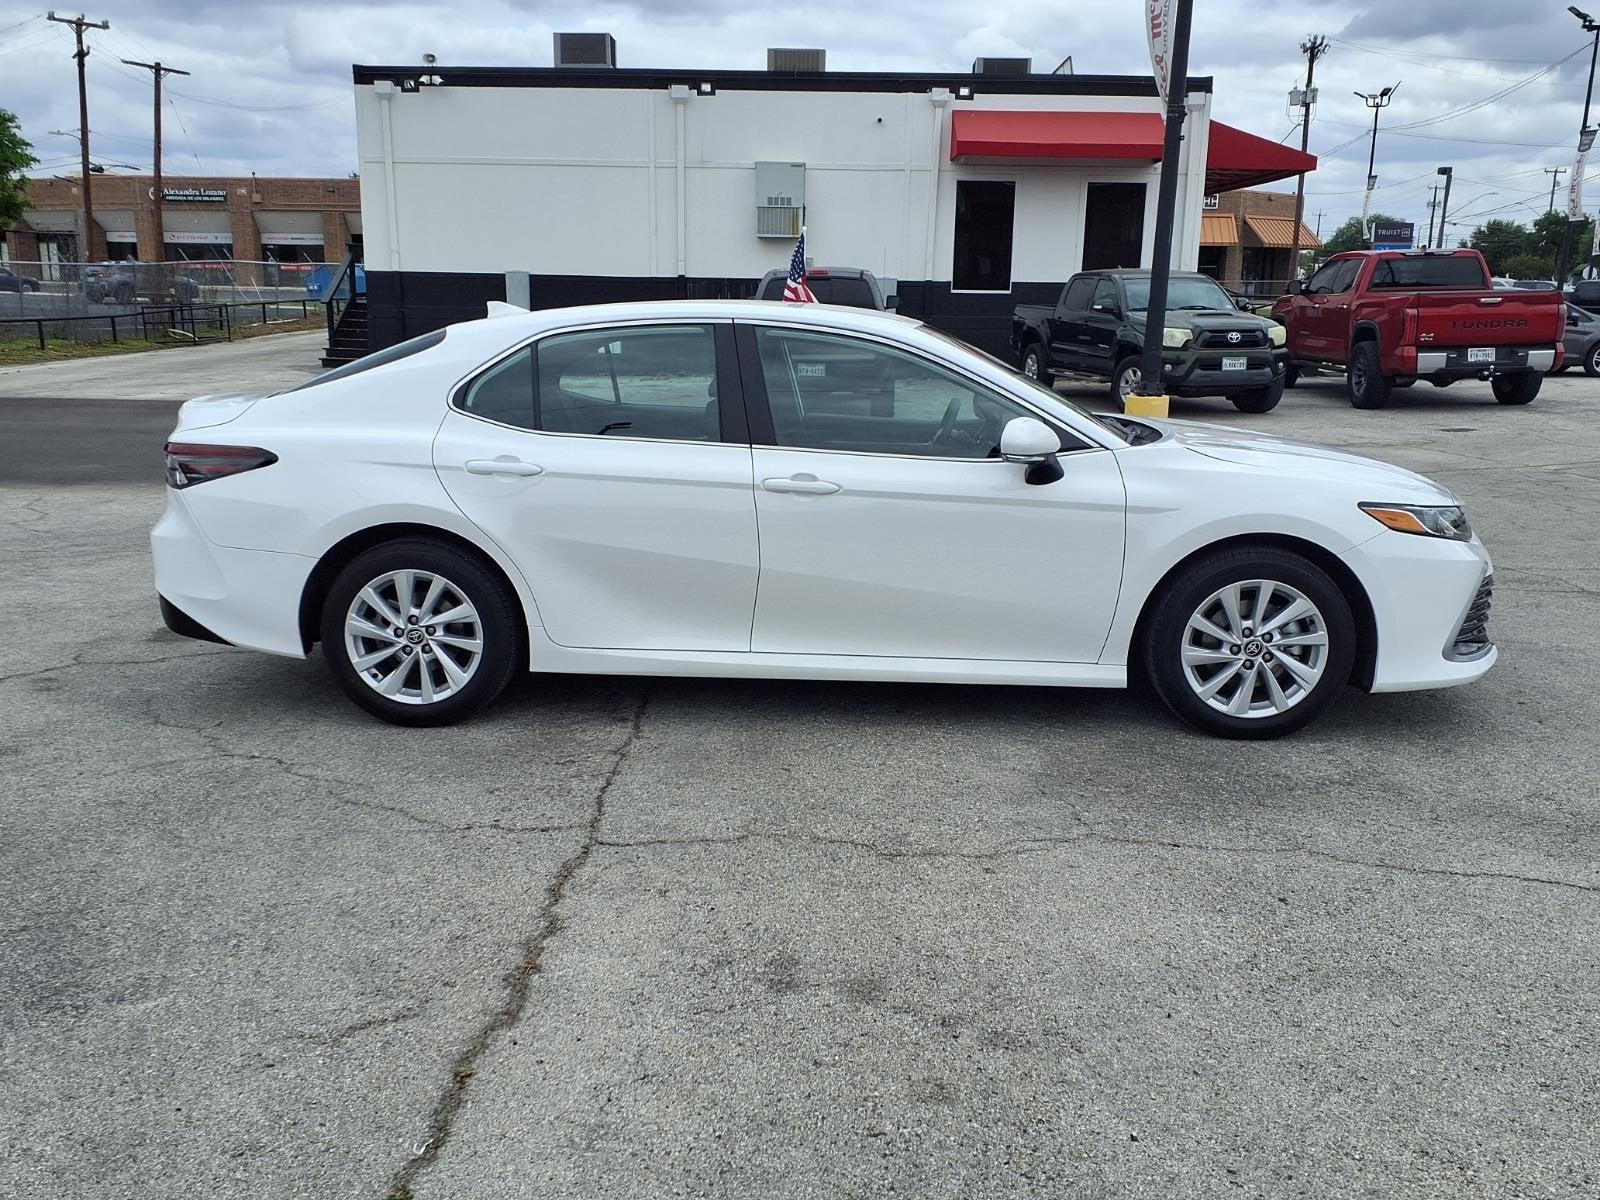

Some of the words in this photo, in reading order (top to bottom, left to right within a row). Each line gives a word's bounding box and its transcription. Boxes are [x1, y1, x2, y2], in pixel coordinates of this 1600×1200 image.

[163, 187, 200, 196] Alexandra
[201, 187, 227, 196] Lozano
[1450, 319, 1529, 329] TUNDRA
